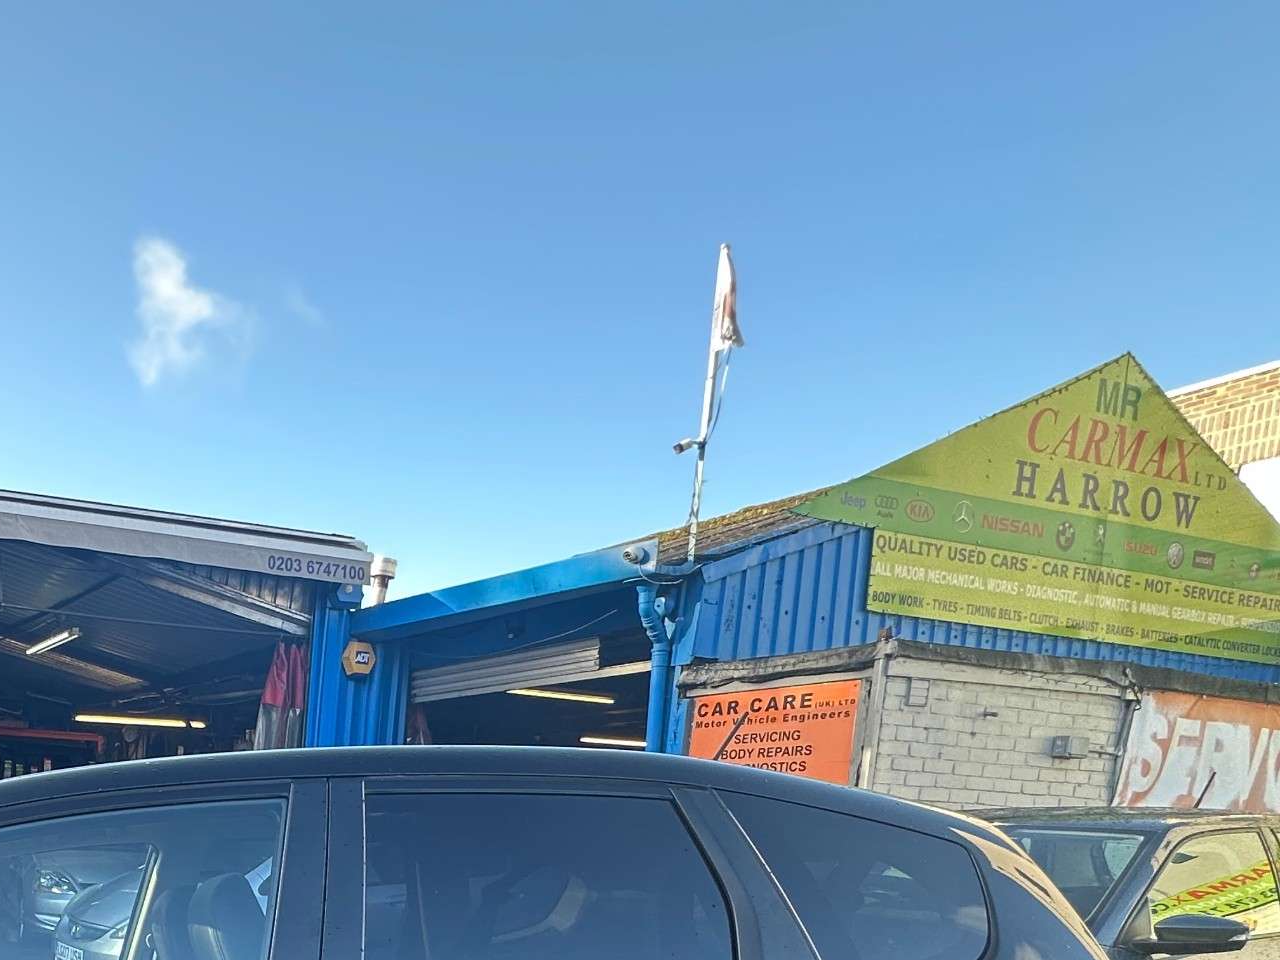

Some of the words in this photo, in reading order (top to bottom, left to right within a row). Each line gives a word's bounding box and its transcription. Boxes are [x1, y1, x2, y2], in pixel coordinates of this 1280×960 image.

[1096, 378, 1142, 421] MR
[1027, 408, 1200, 484] CARMAX
[1194, 471, 1227, 491] LTD
[1012, 459, 1200, 529] HARROW
[981, 514, 1044, 537] NISSAN
[267, 555, 302, 572] 0203
[306, 560, 365, 580] 6747100
[876, 534, 944, 558] QUALITY
[948, 546, 986, 566] USED
[991, 554, 1028, 572] CARS
[1042, 561, 1069, 578] CAR
[1073, 564, 1132, 589] FINANCE
[1144, 578, 1172, 595] MOT
[1183, 584, 1235, 605] SERVICE
[874, 561, 891, 576] ALL
[895, 563, 927, 581] MAJOR
[927, 570, 985, 591] MECHANICAL
[987, 577, 1018, 595] WORKS
[1083, 593, 1131, 613] AUTOMATIC
[1140, 600, 1170, 618] MANUAL
[872, 590, 896, 604] BODY
[898, 594, 923, 608] WORK
[932, 598, 958, 613] TYRES
[966, 603, 997, 619] TIMING
[998, 607, 1021, 622] BELTS
[1029, 612, 1059, 627] CLUTCH
[1066, 617, 1099, 633] EXHAUST
[1105, 624, 1134, 637] BRAKES
[1184, 634, 1221, 650] CATALYTIC
[695, 718, 727, 729] Motor
[782, 709, 851, 724] Engineers
[697, 701, 739, 718] CAR
[749, 692, 814, 713] CARE
[838, 698, 856, 706] LTD
[721, 748, 754, 760] BODY
[757, 744, 813, 758] REPAIRS
[734, 730, 801, 744] SERVICING
